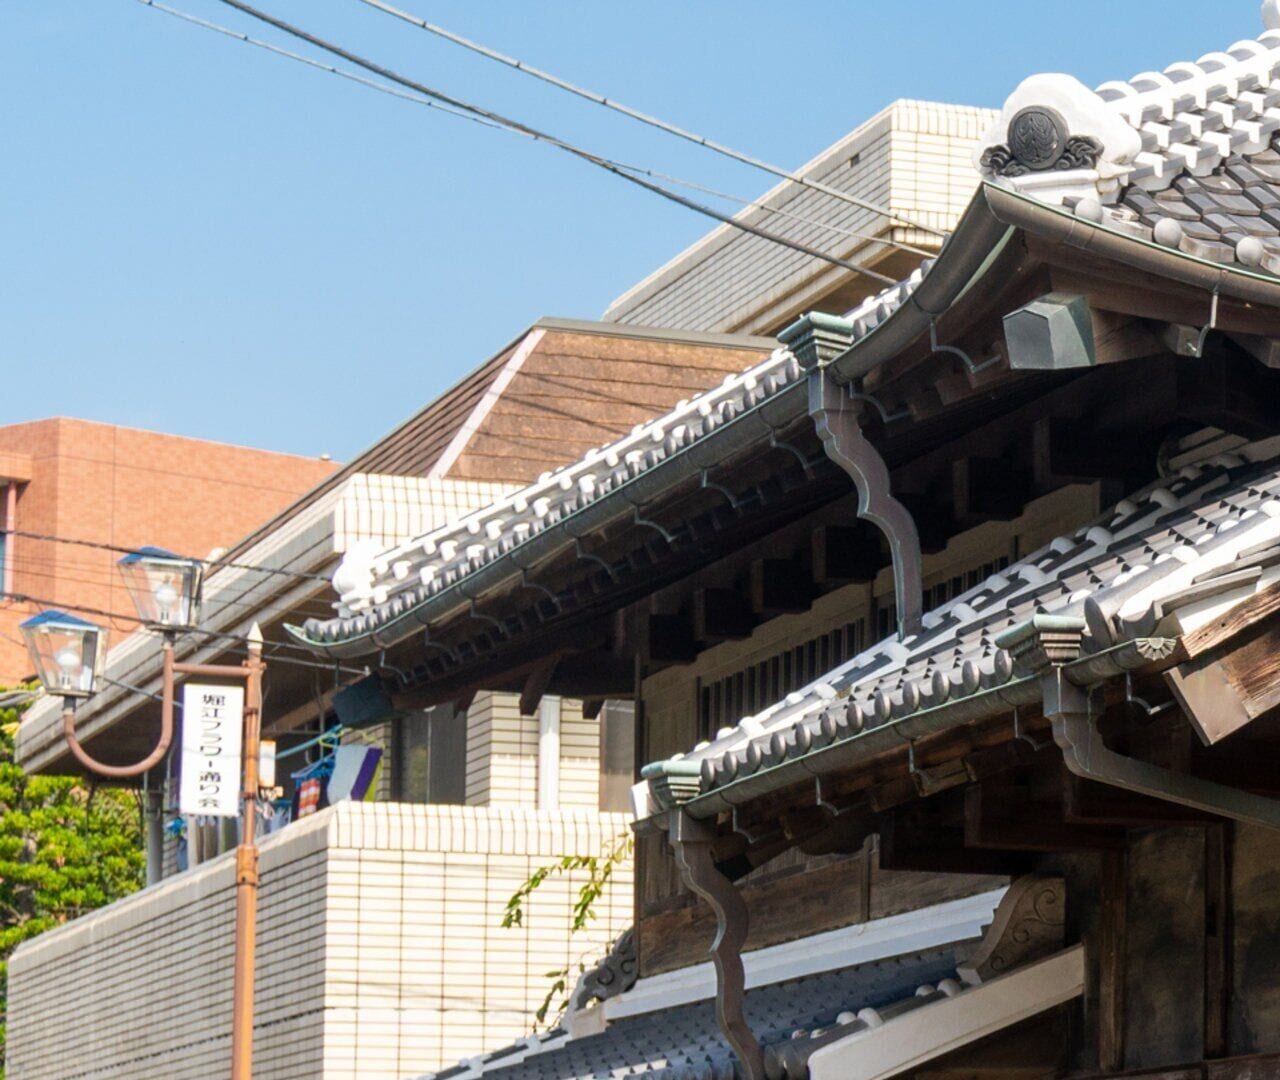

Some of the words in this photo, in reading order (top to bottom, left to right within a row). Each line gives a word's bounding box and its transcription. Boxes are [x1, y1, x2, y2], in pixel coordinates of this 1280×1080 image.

[199, 694, 225, 808] 堀江フラワー通り会
